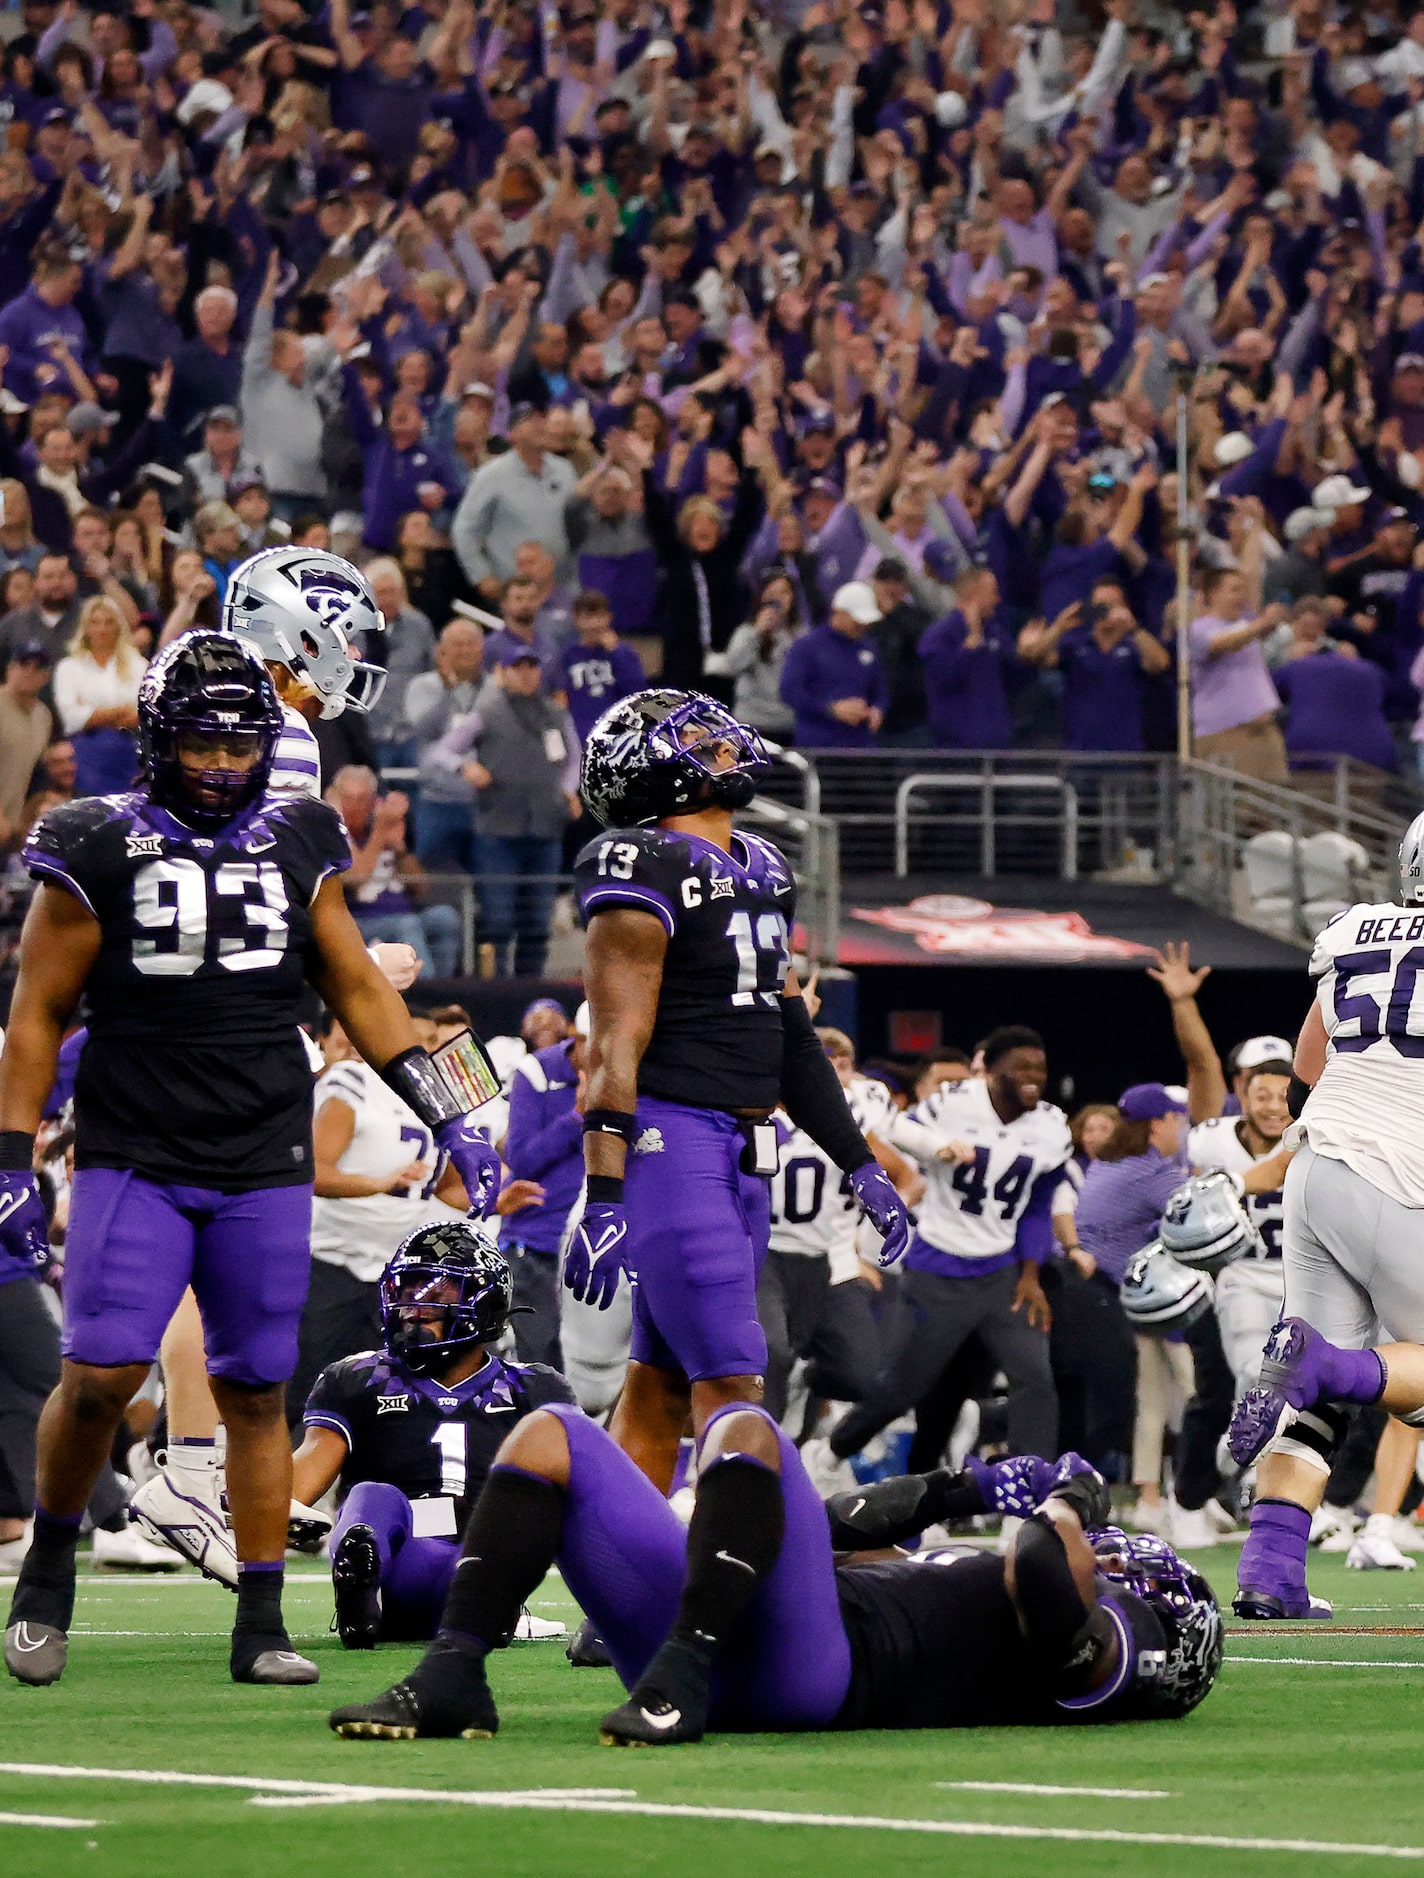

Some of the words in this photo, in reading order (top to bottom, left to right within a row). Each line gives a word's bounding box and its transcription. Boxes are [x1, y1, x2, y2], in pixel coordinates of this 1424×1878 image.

[217, 711, 240, 723] TCU
[598, 841, 640, 880] 13
[1409, 866, 1420, 878] 50
[681, 876, 703, 909] C
[131, 857, 291, 976] 93
[952, 1145, 1034, 1220] 44
[437, 1397, 459, 1407] TCU
[430, 1422, 468, 1497] 1
